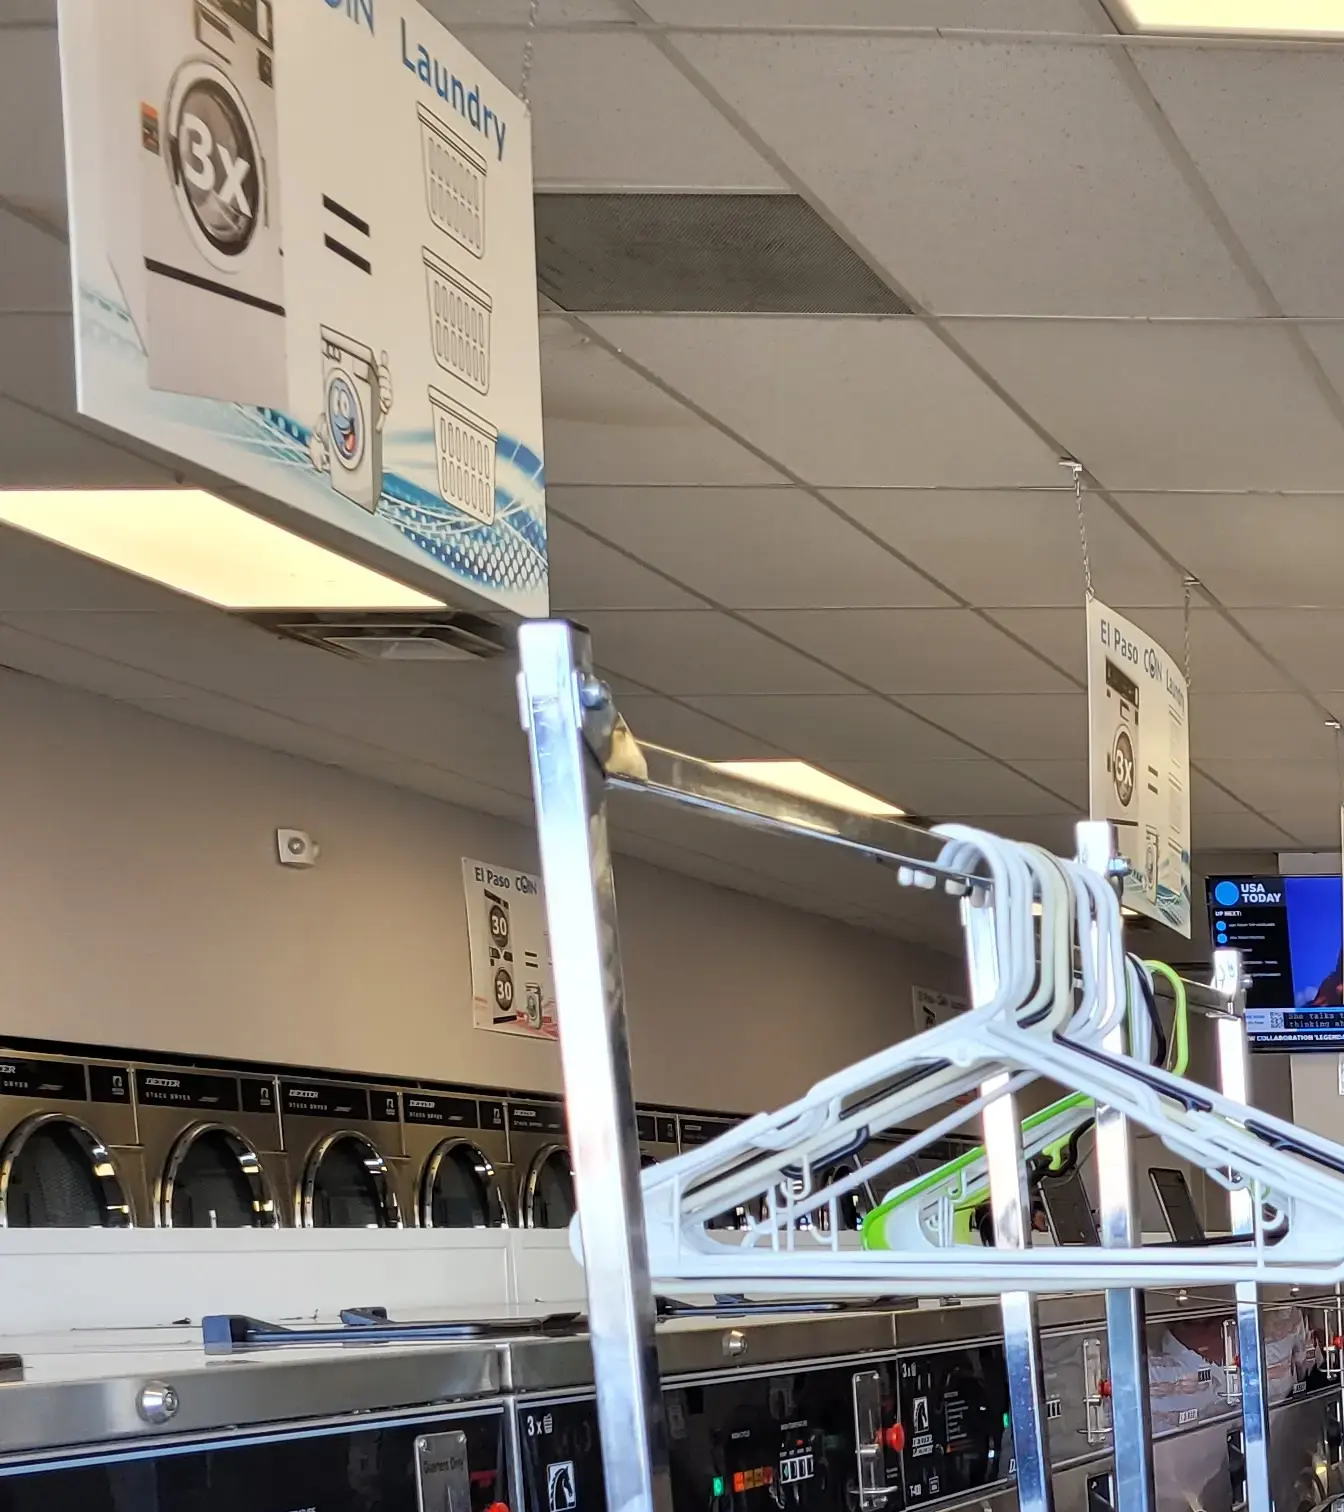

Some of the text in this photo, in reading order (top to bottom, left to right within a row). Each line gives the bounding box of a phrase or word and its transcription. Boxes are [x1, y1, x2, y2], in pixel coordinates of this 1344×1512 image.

[400, 16, 507, 162] Laundry
[1100, 619, 1185, 713] El Paso COIN Laundry
[474, 867, 538, 895] El Paso COIN
[1240, 883, 1266, 893] USA
[1240, 892, 1282, 904] TODAY
[491, 914, 508, 936] 30
[496, 979, 513, 1001] 30
[145, 1077, 181, 1089] DEXTER
[527, 1415, 535, 1437] 3
